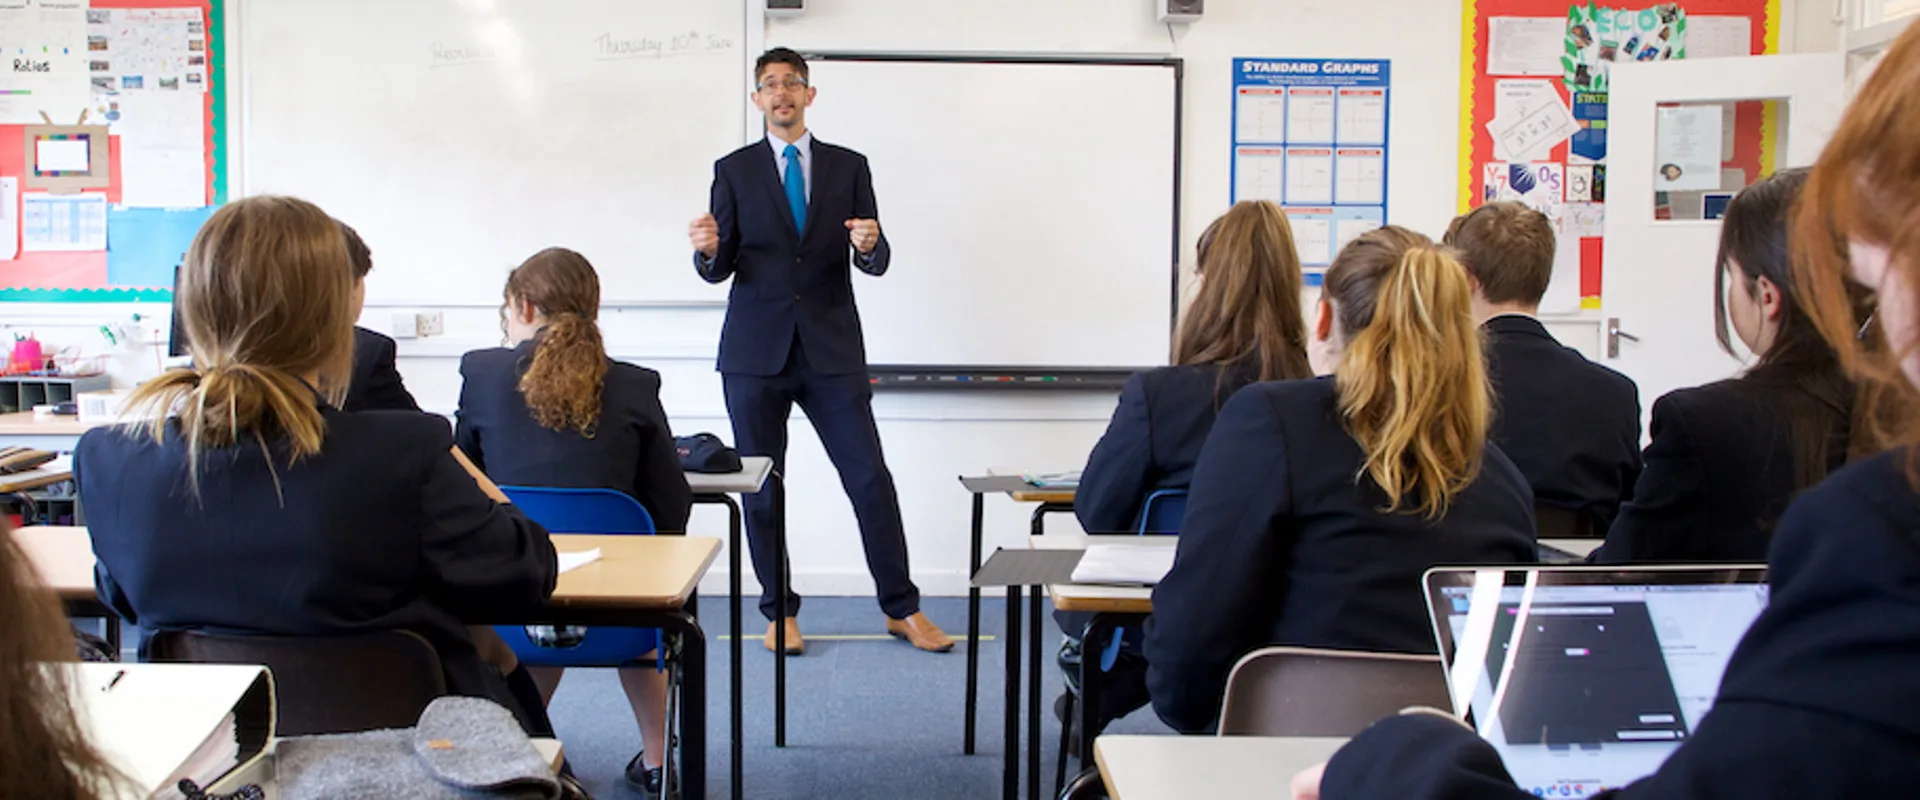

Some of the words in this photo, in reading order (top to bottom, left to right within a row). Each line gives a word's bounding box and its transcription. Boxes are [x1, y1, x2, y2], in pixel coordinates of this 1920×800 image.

[1596, 7, 1657, 33] ECO
[594, 32, 662, 58] Thursday
[12, 58, 51, 72] Ratios
[1242, 61, 1319, 74] STANDARD
[1322, 62, 1380, 75] GRAPHS
